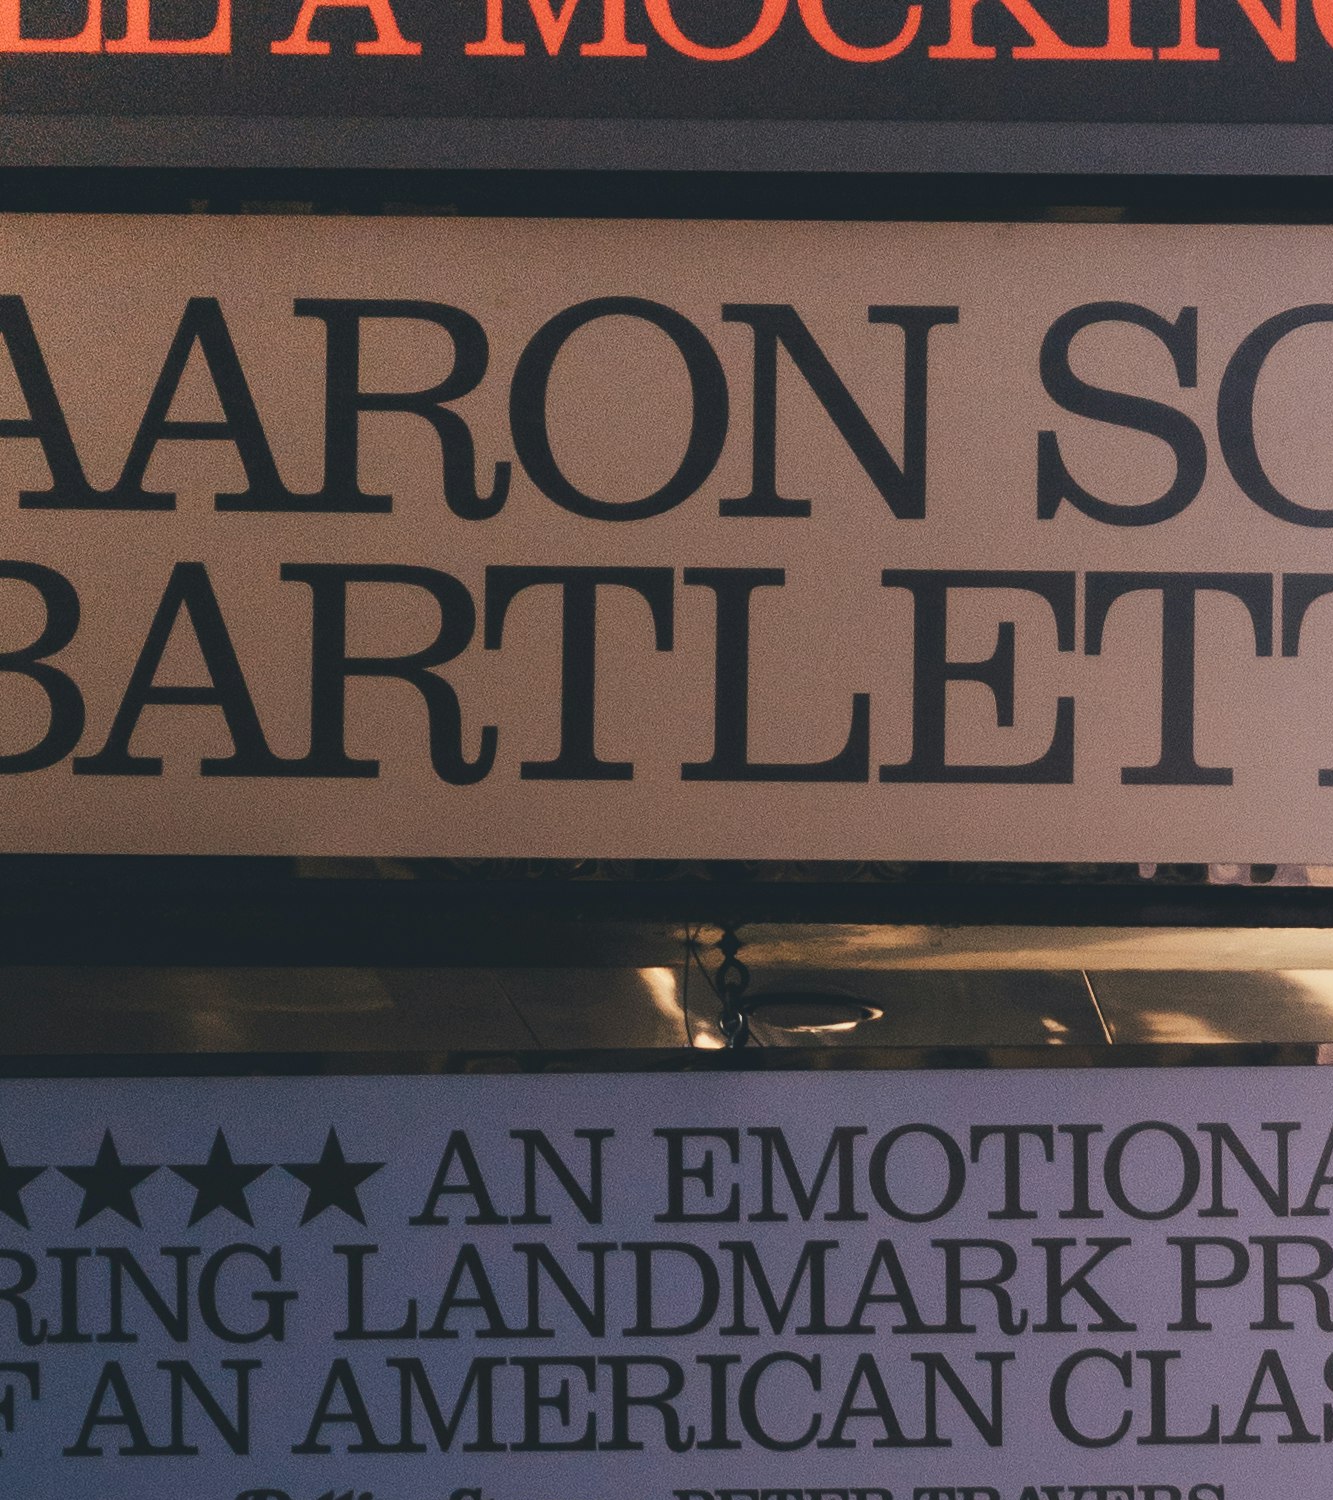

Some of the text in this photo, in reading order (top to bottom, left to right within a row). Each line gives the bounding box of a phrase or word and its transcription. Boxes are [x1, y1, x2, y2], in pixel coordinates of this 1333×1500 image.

[410, 1127, 615, 1226] AN
[333, 1235, 1137, 1340] LANDMARK
[62, 1360, 263, 1457] AN
[291, 1351, 1015, 1455] AMERICAN
